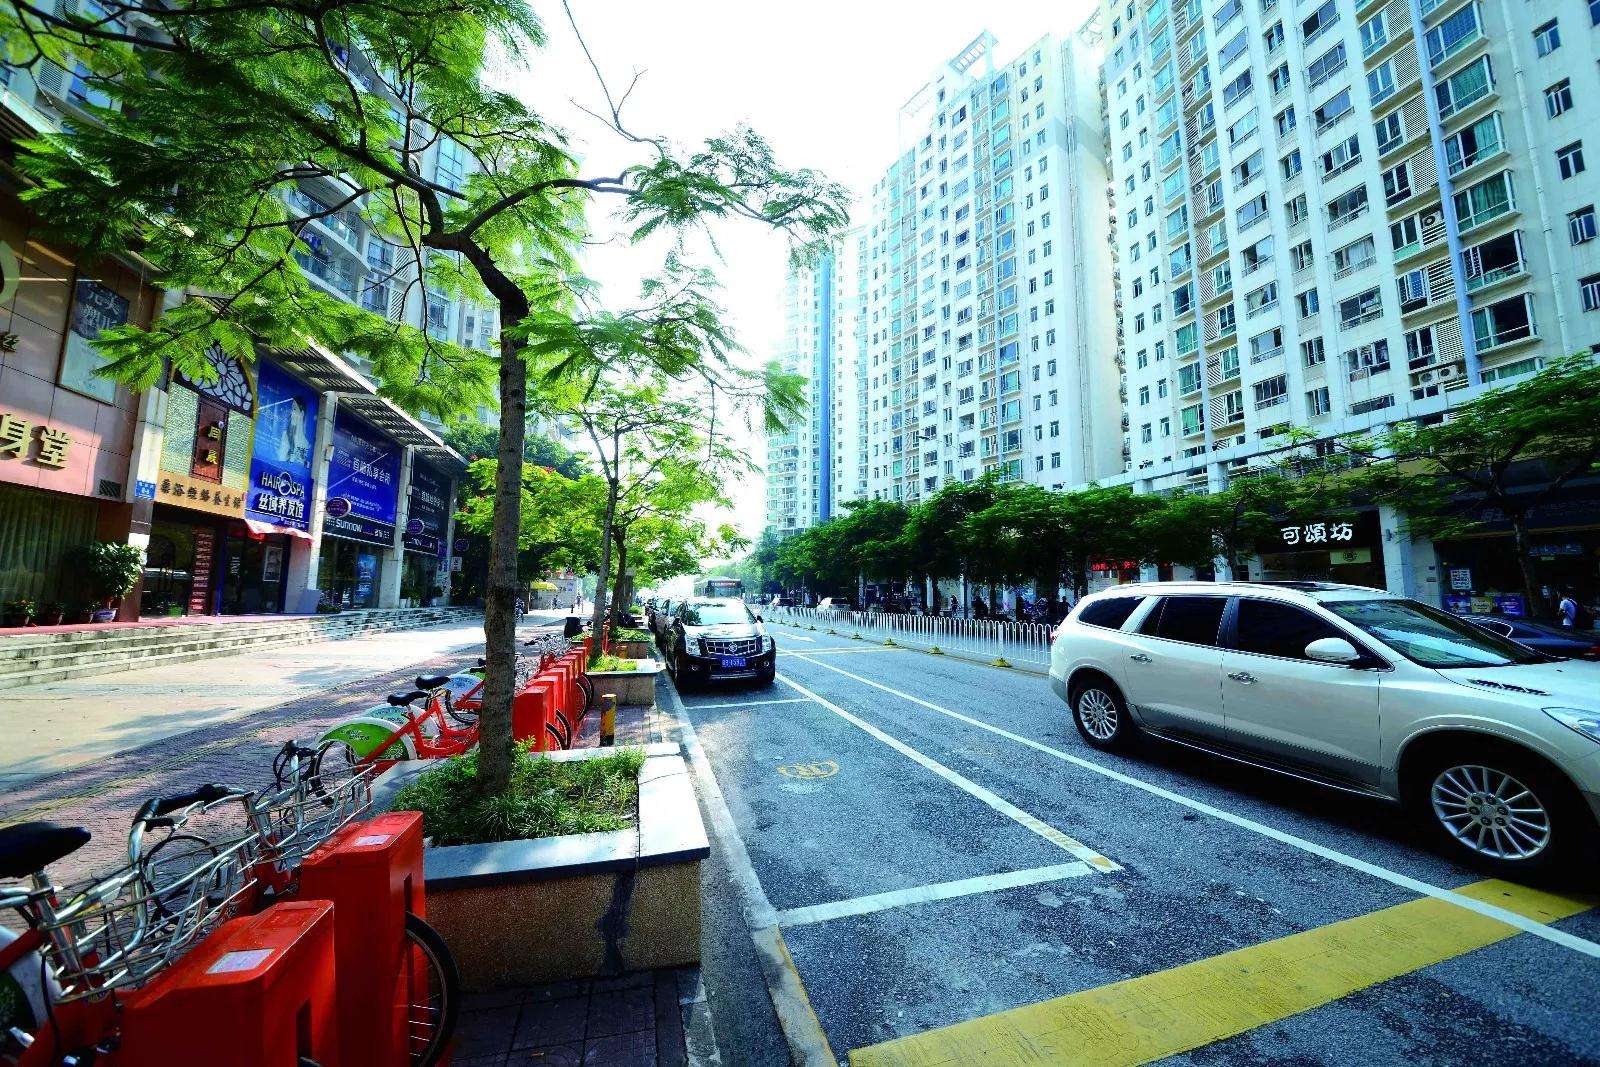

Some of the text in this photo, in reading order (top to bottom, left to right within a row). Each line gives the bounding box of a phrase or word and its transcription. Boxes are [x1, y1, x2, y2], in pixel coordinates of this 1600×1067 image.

[261, 471, 305, 498] HAIR SPA
[1280, 521, 1354, 545] 可頌坊
